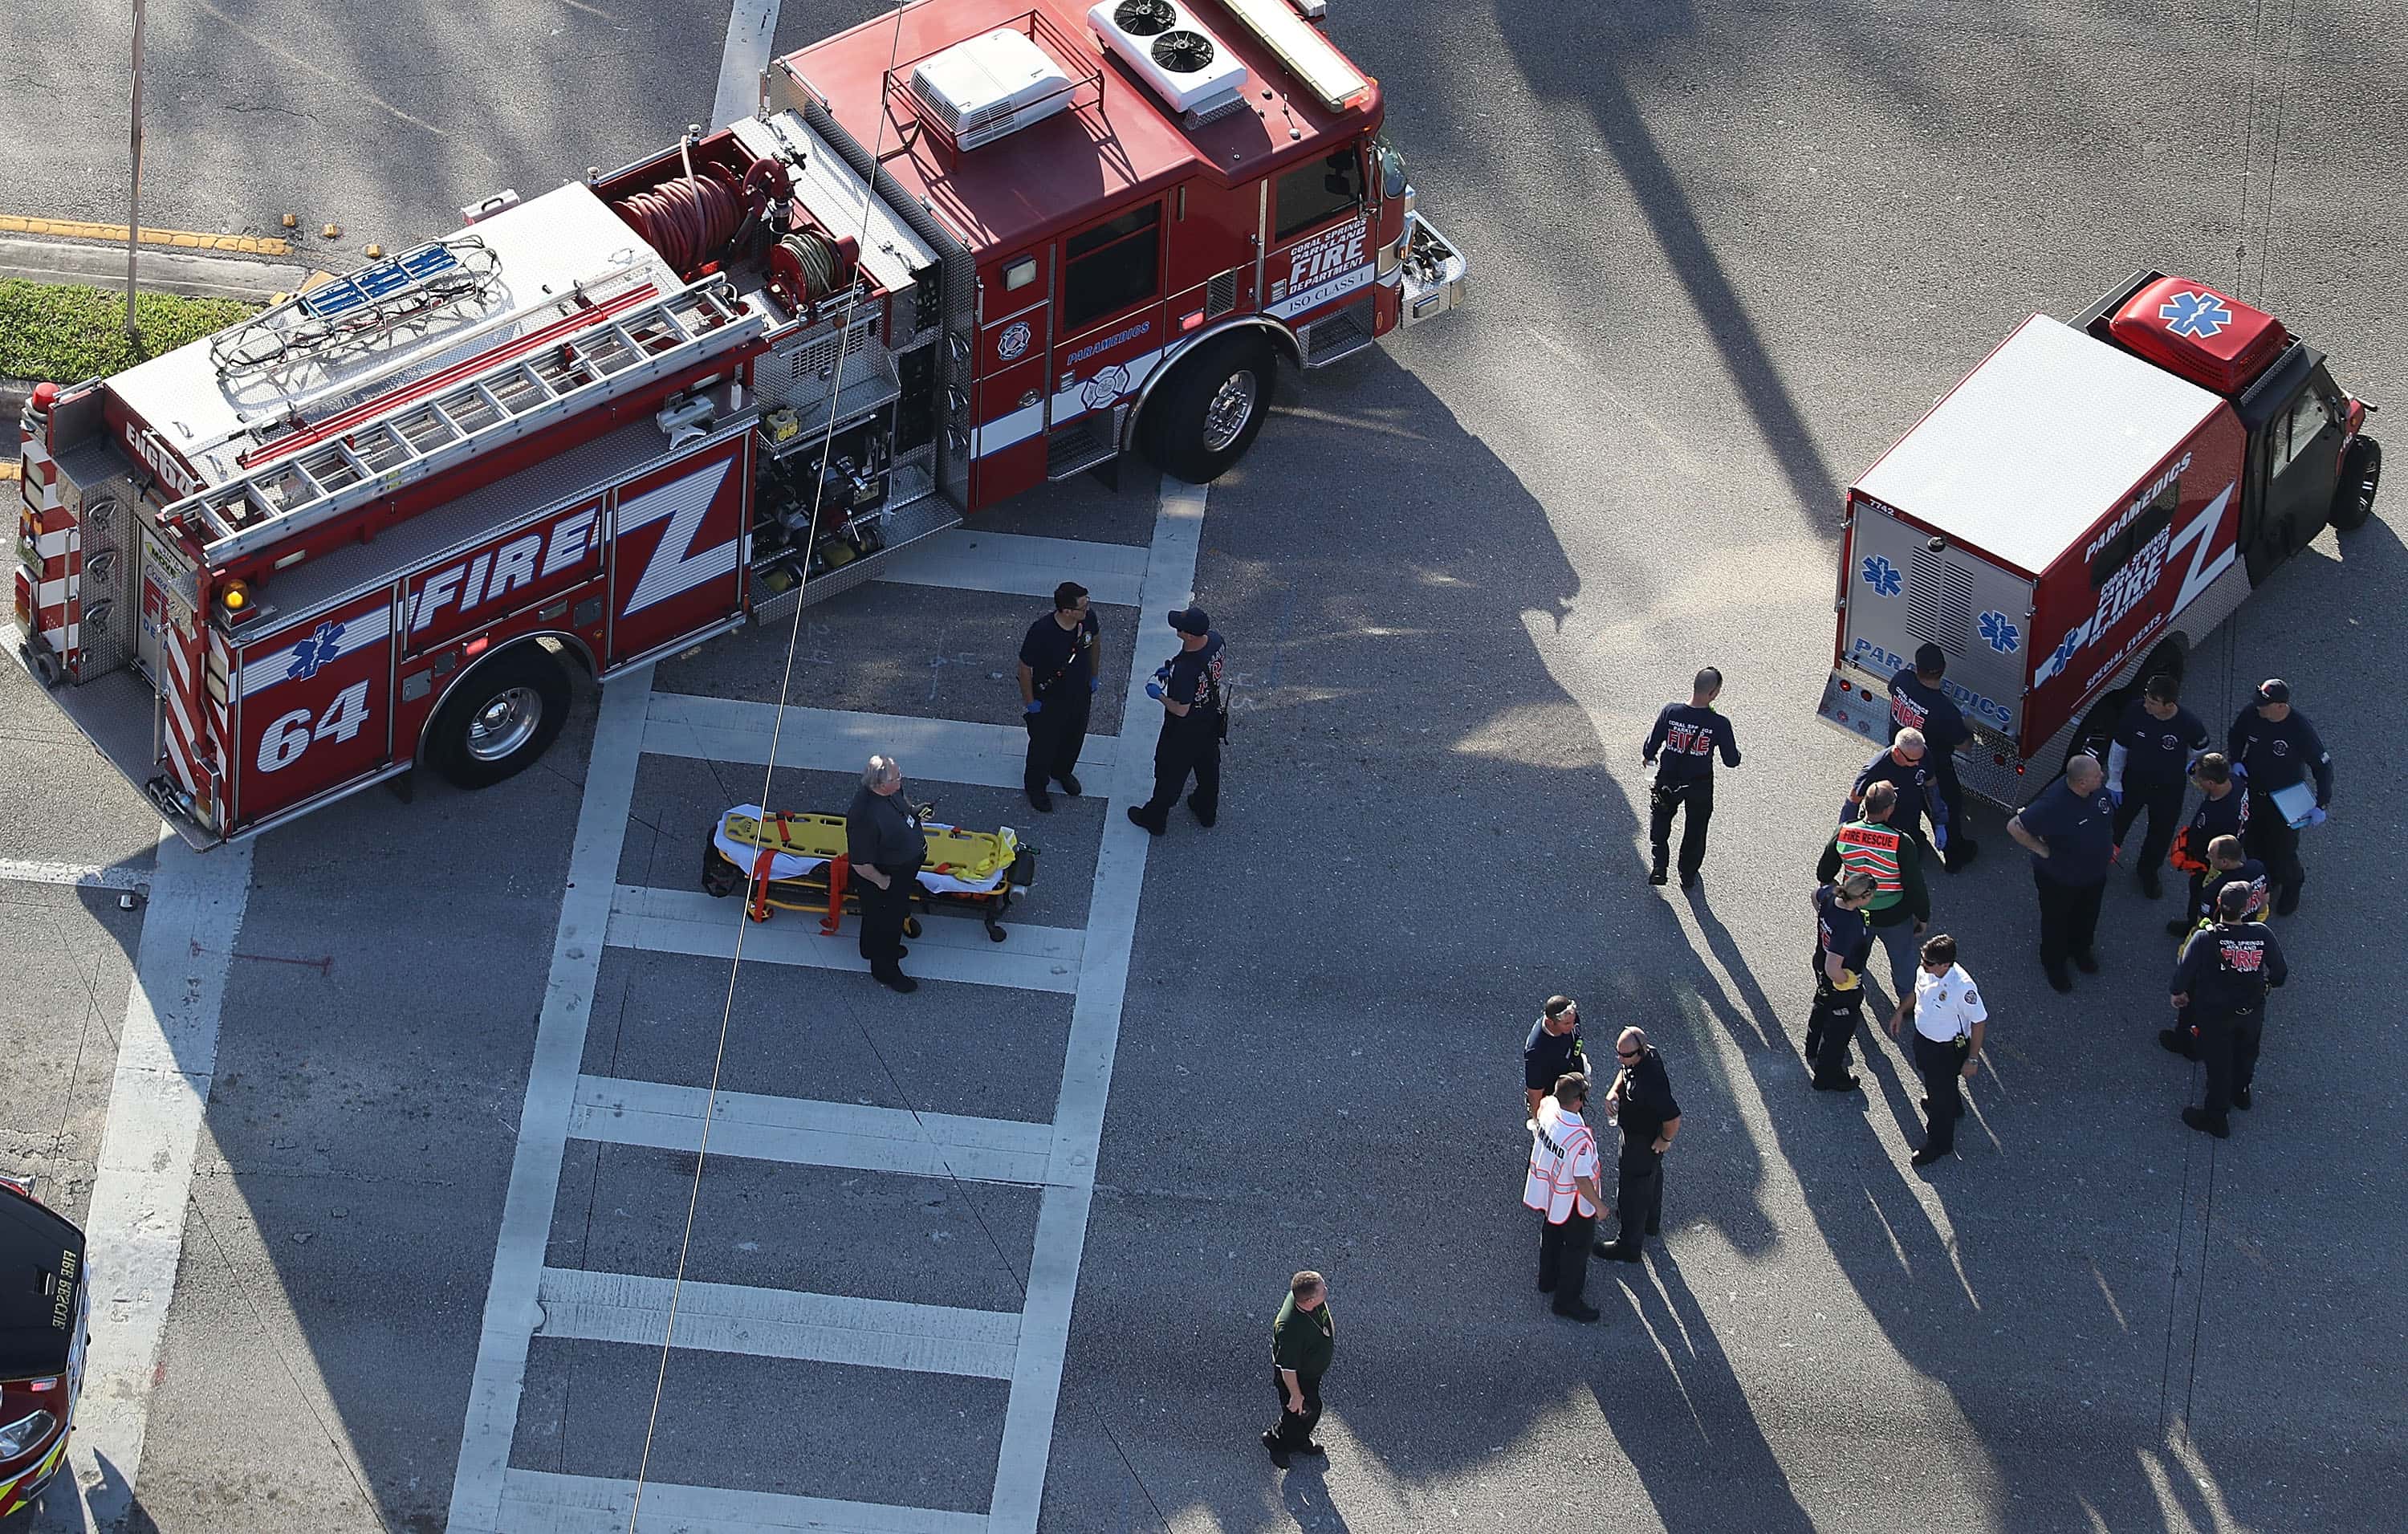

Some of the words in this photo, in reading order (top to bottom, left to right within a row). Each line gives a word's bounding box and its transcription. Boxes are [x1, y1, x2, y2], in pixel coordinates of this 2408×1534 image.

[1290, 238, 1322, 256] CORAL
[1324, 218, 1368, 242] SPRINGS
[1291, 226, 1367, 264] PARKLAND
[1289, 233, 1367, 287] FIRE
[1289, 255, 1366, 295] DEPARTMENT
[1290, 295, 1311, 311] ISO
[1315, 276, 1355, 300] CLASS
[1067, 320, 1150, 366] PARAMEDICS
[1869, 498, 1895, 516] 7742
[2084, 451, 2193, 564] PARAMEDICS
[2132, 522, 2172, 567] SPRINGS
[410, 506, 599, 633] FIRE
[2092, 547, 2166, 636] FIRE
[2097, 534, 2170, 608] PARKLAND
[2088, 572, 2161, 649] DEPARTMENT
[2085, 649, 2124, 690] SPECIAL
[2126, 612, 2162, 652] EVENTS
[256, 678, 371, 773] 64
[1891, 694, 1926, 730] FIRE
[1843, 829, 1861, 842] FIRE
[1862, 832, 1893, 848] RESCUE
[2220, 947, 2264, 969] FIRE
